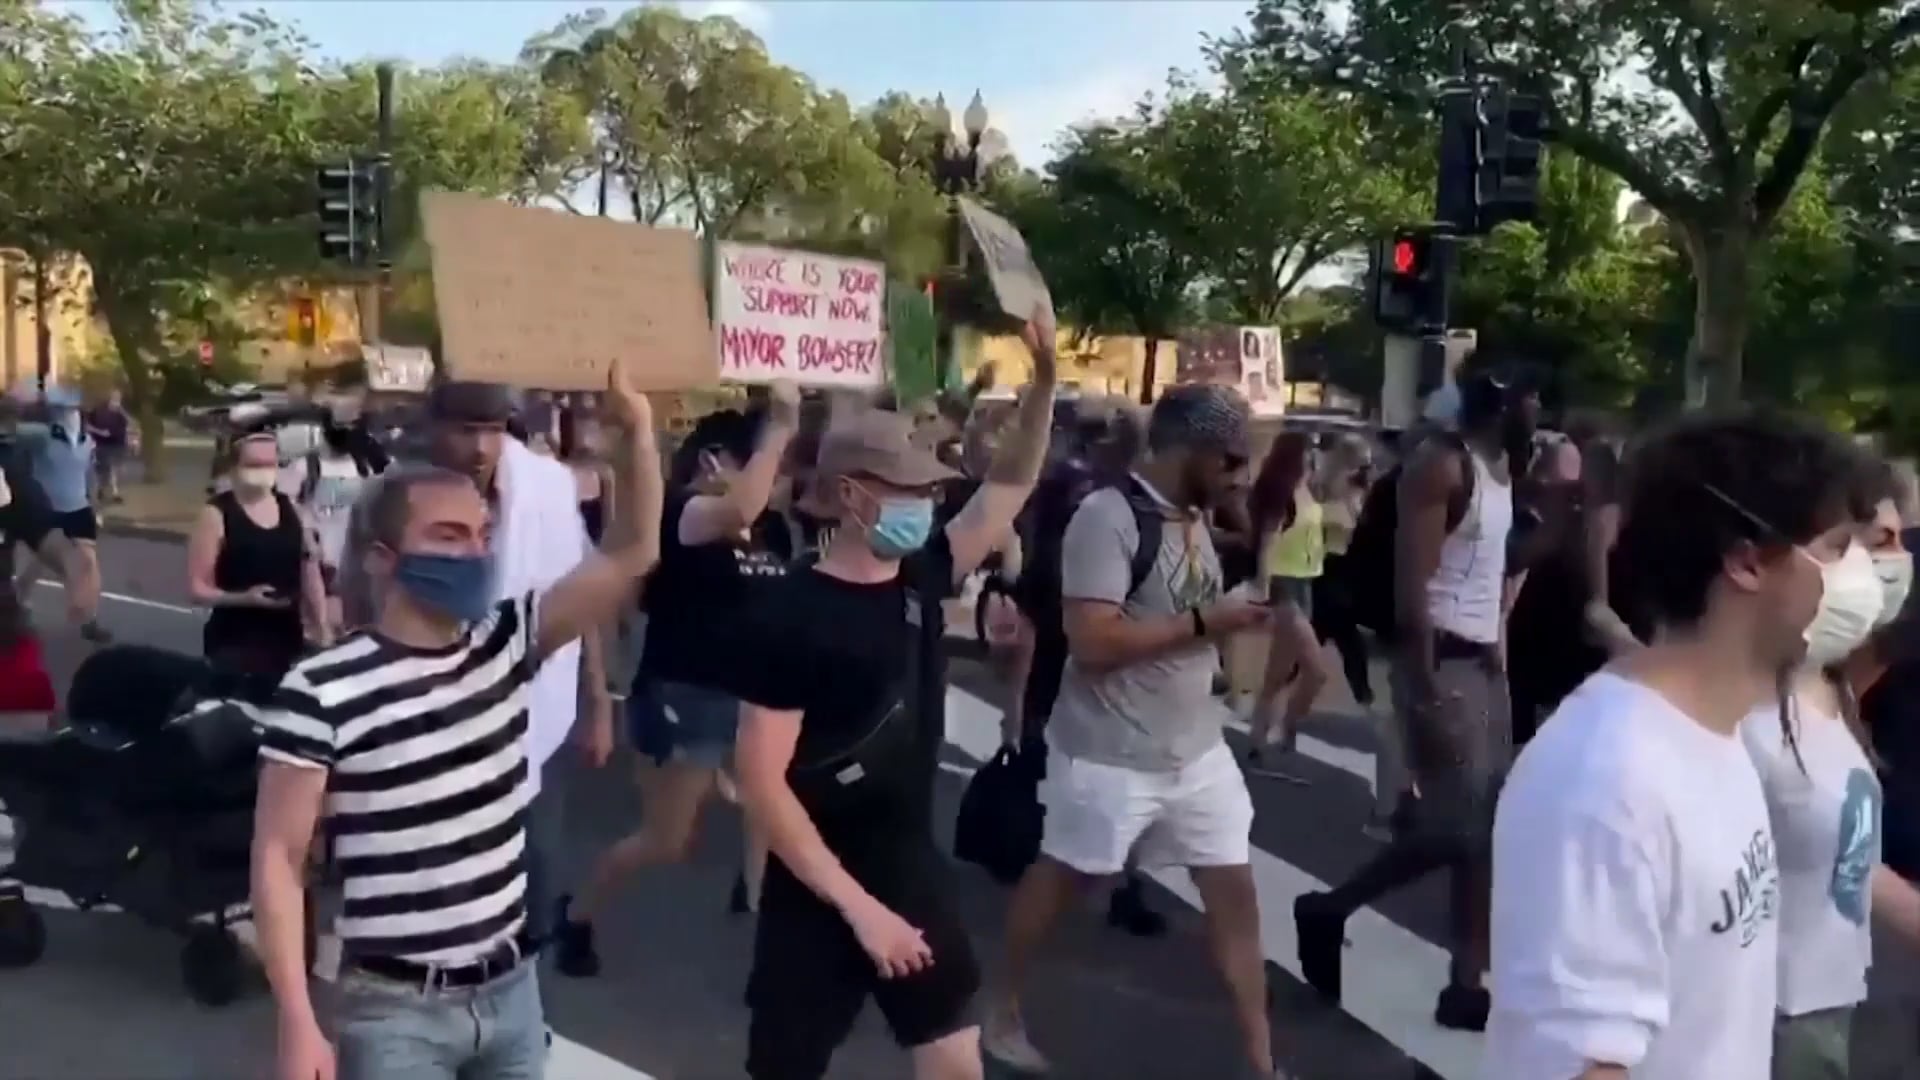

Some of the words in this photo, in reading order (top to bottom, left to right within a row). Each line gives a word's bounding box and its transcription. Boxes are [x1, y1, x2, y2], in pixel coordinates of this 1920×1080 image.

[724, 256, 786, 284] WHERE
[801, 263, 821, 286] IS
[838, 268, 879, 294] YOUR
[744, 286, 818, 319] SUPPORT
[720, 323, 785, 369] MAYOR
